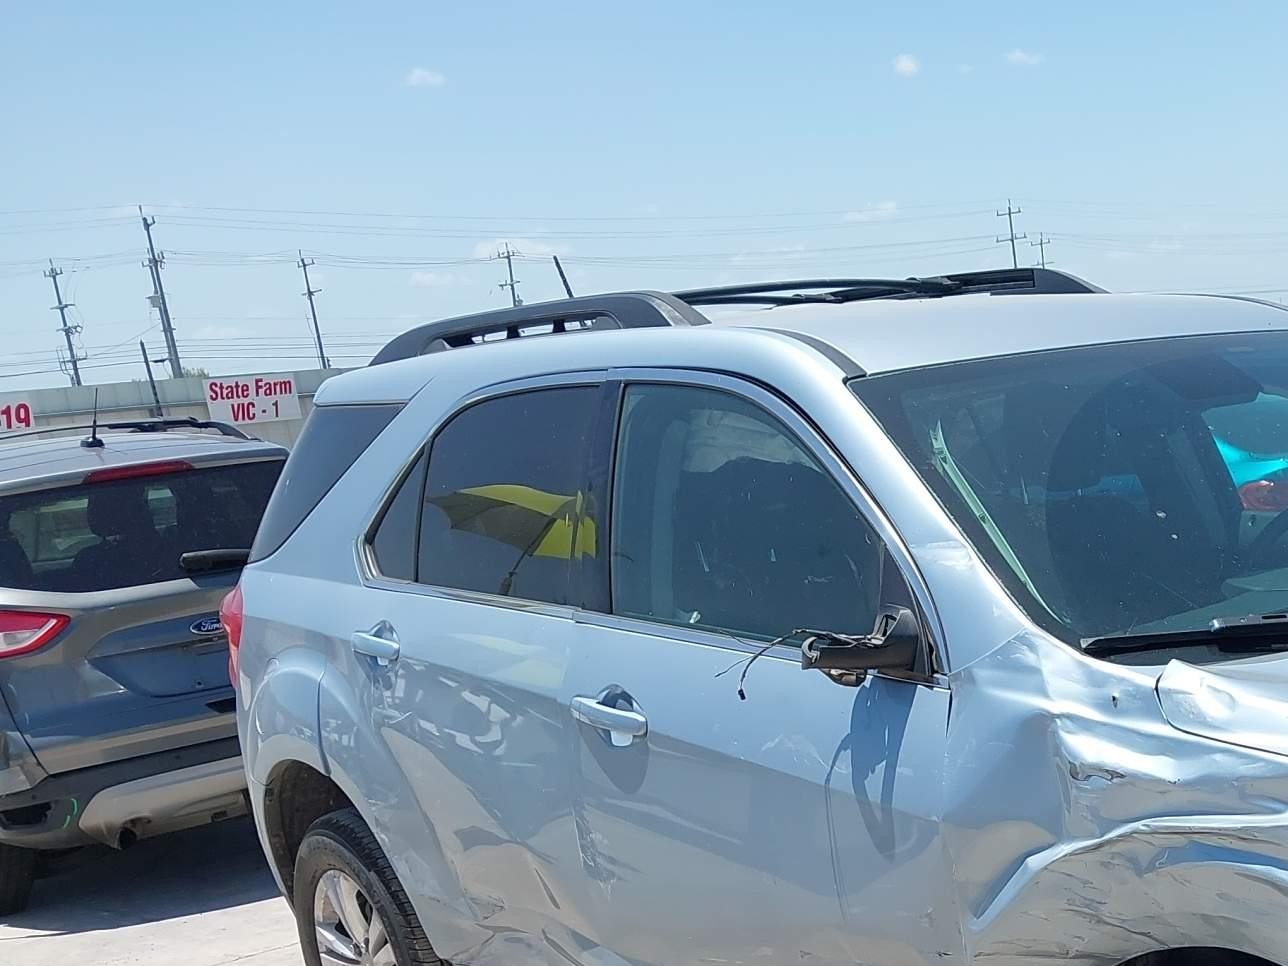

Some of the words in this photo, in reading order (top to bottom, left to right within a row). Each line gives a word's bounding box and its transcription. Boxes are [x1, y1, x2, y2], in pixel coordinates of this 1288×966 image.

[208, 381, 250, 402] State
[255, 378, 292, 398] Farm
[230, 401, 256, 422] VIC
[272, 400, 280, 418] 1
